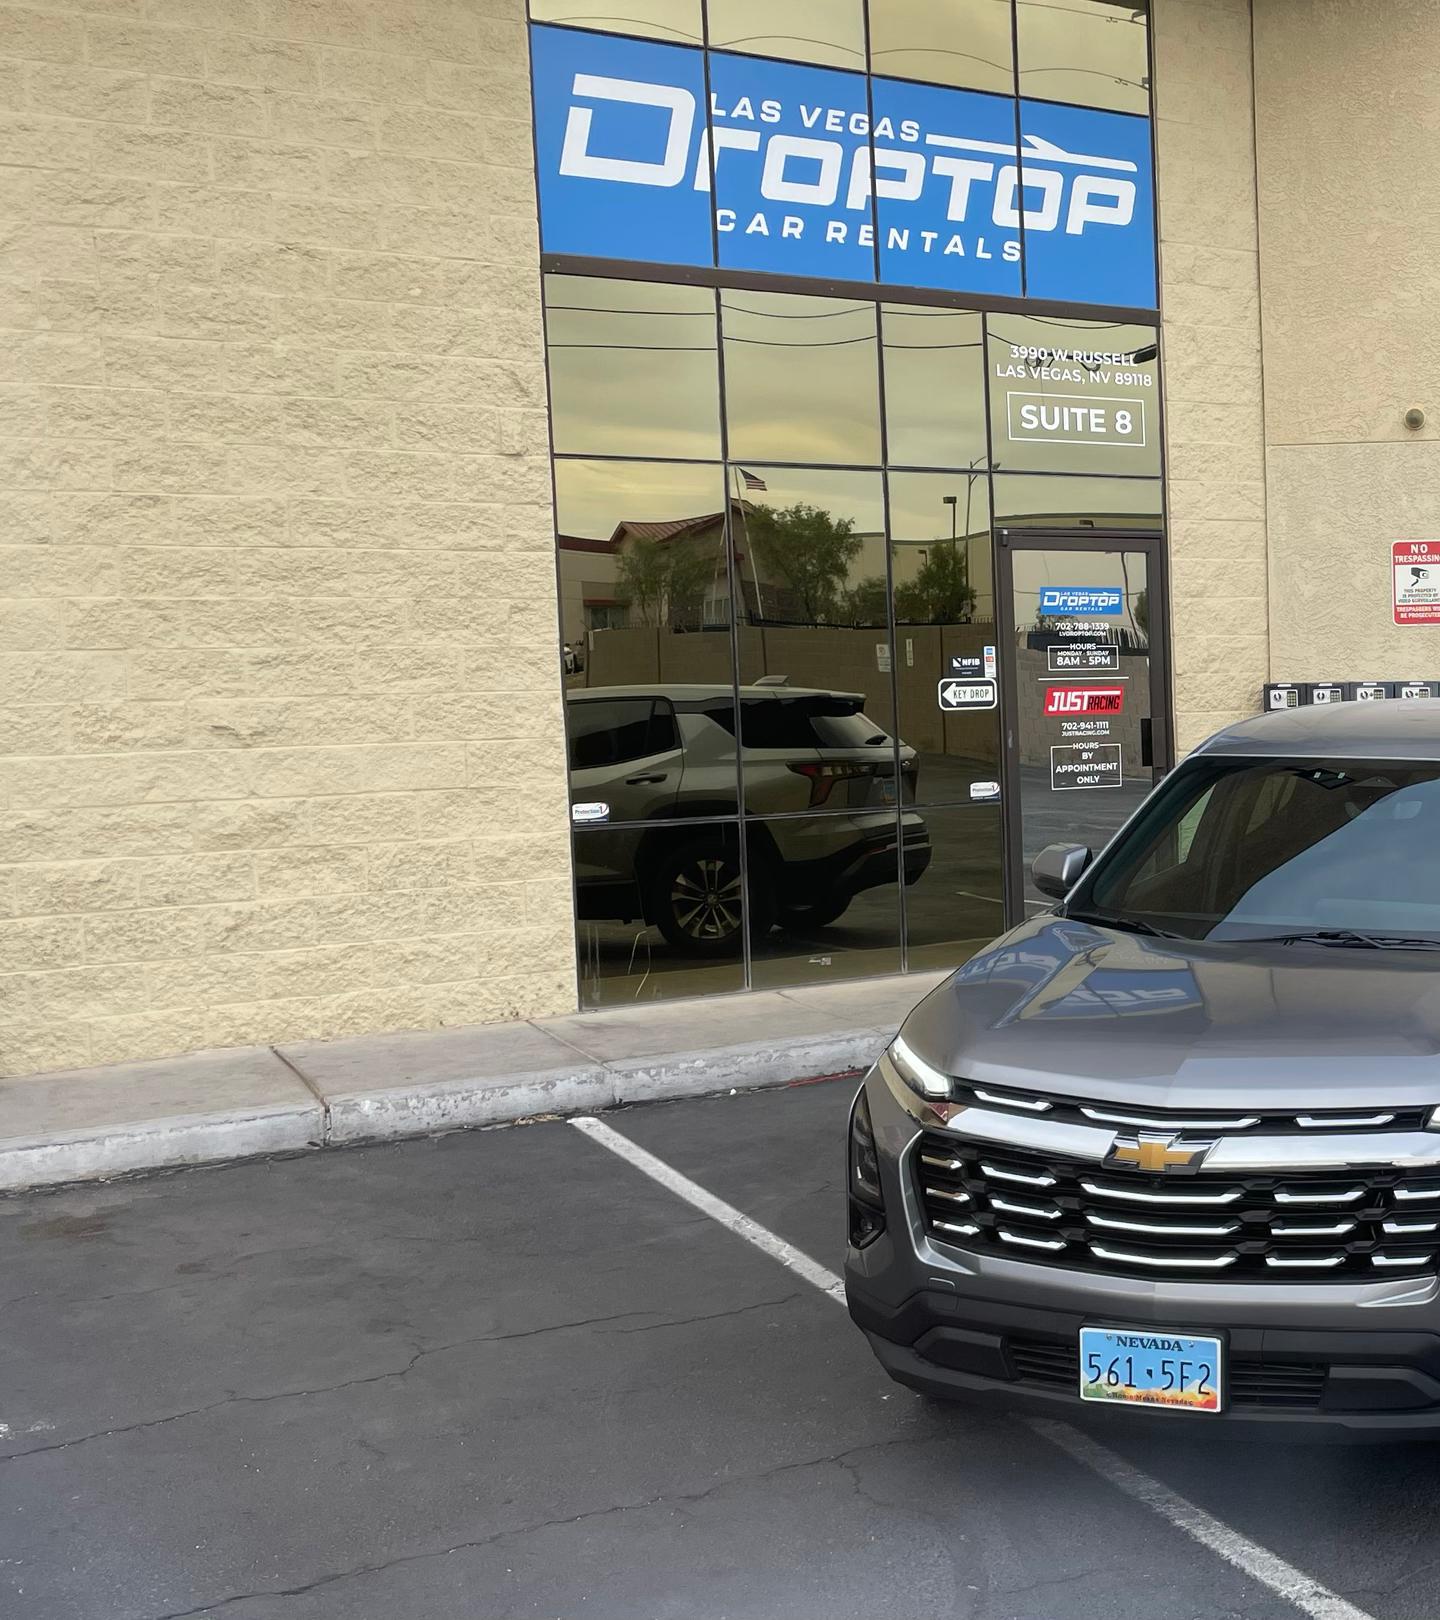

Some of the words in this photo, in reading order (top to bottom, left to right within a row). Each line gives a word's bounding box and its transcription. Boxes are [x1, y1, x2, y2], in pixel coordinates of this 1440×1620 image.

[711, 93, 782, 123] LAS
[800, 105, 920, 142] VEGAS
[716, 209, 804, 239] CAR
[825, 221, 1023, 262] RENTALS
[1010, 345, 1048, 360] 3990
[1073, 350, 1138, 367] RUSSELL
[996, 364, 1026, 379] LAS
[1030, 367, 1086, 385] VEGAS,
[1090, 371, 1111, 384] NV
[1114, 372, 1153, 387] 89118
[1020, 404, 1107, 433] SUITE
[1115, 410, 1133, 434] 8
[1411, 544, 1428, 554] NO
[962, 658, 980, 666] NFIB
[1056, 656, 1080, 666] 8AM
[1088, 656, 1111, 665] 5PM
[953, 689, 967, 699] KEY
[970, 689, 990, 699] DROP
[1062, 721, 1109, 730] 702-941-1111
[1072, 742, 1100, 750] HOURS
[1082, 752, 1093, 760] BY
[1056, 762, 1118, 773] APPOINTMENT
[1077, 776, 1100, 784] ONLY
[1116, 1335, 1184, 1352] NEVADA
